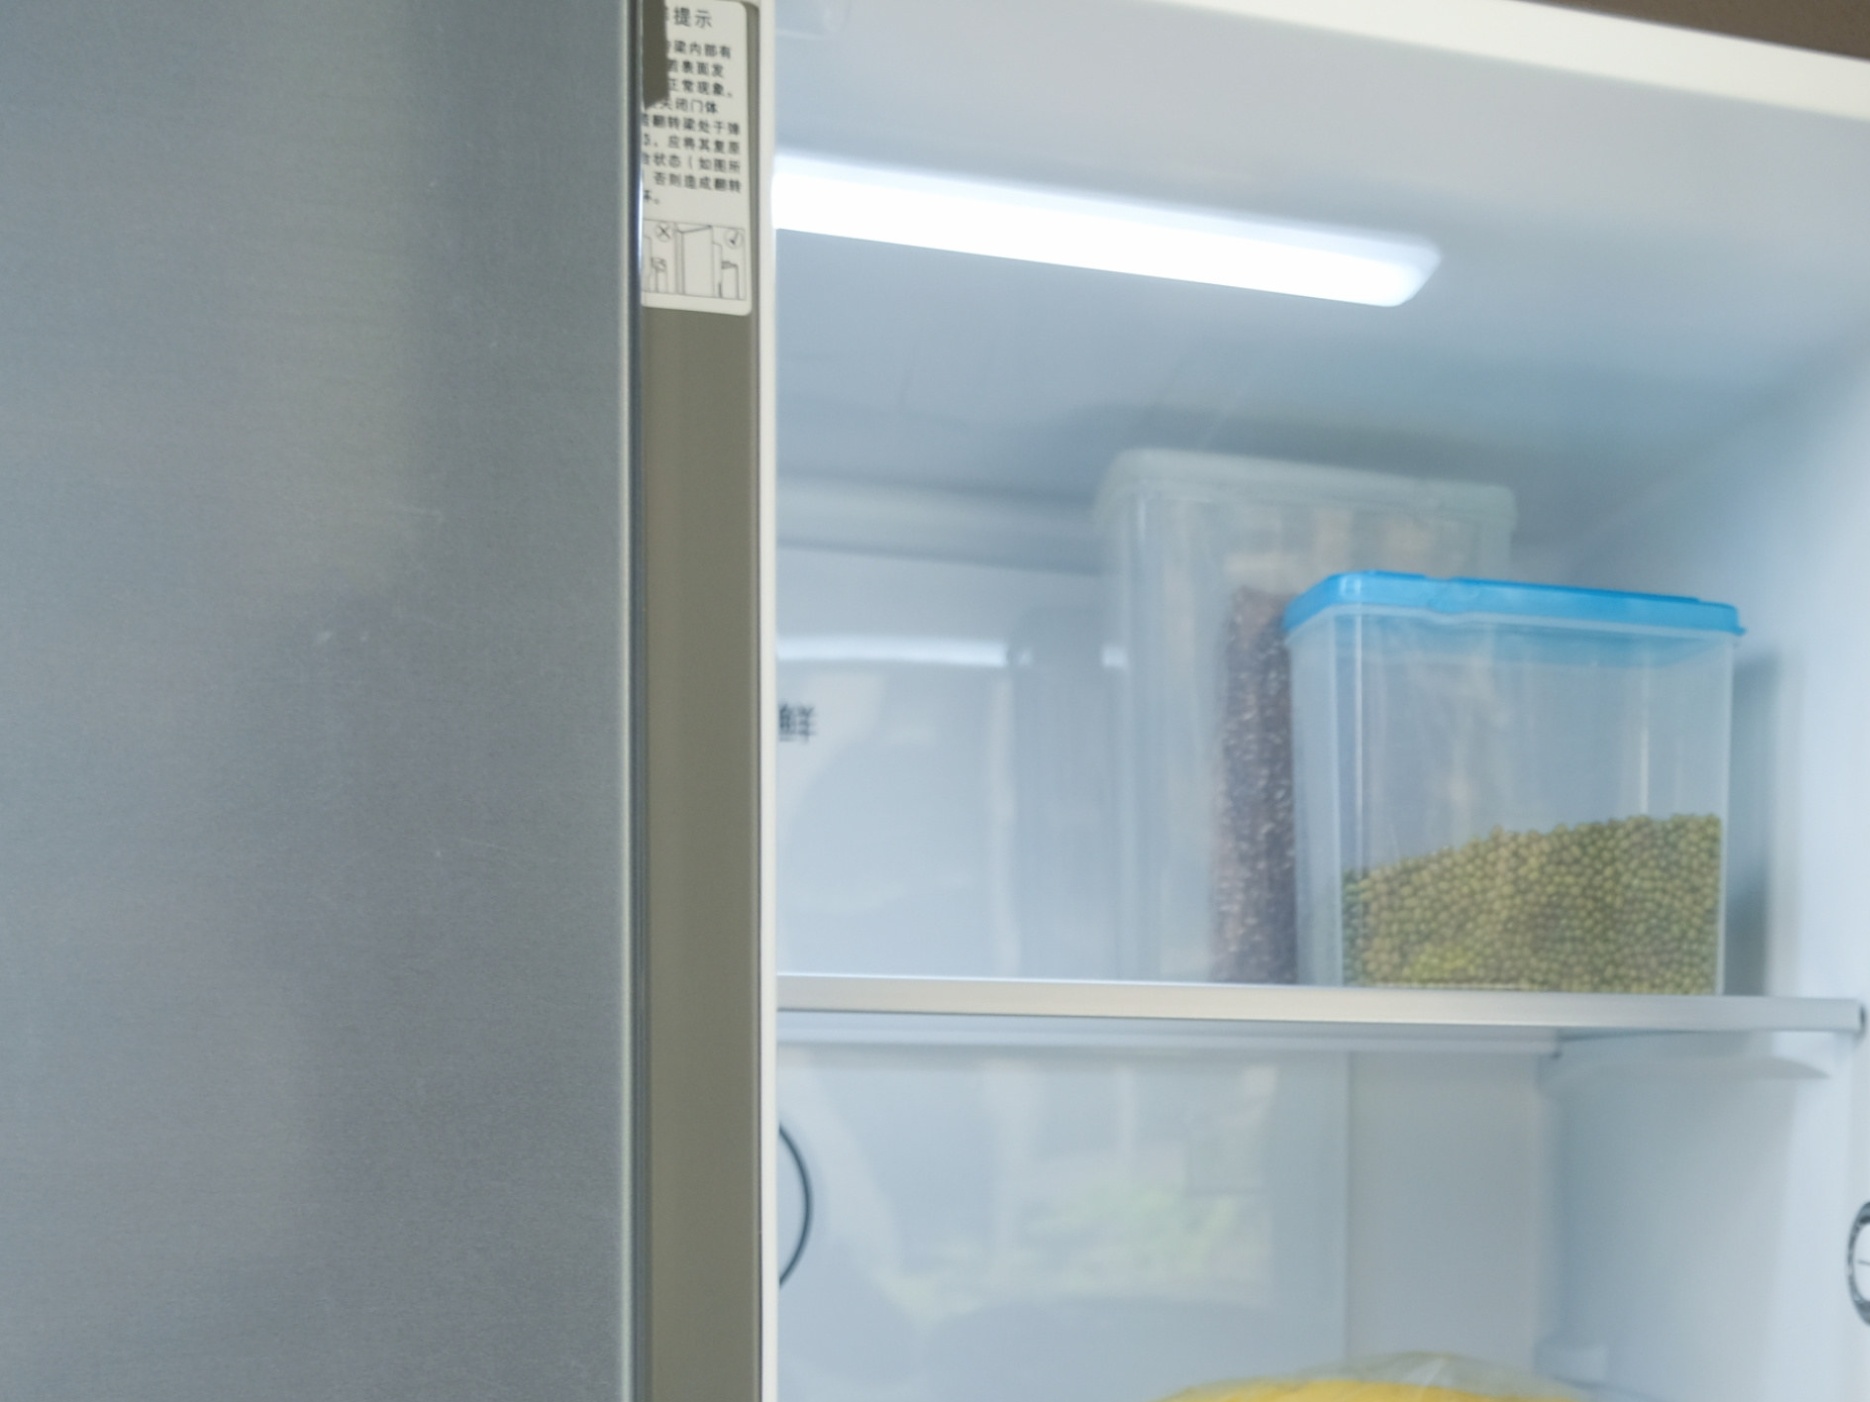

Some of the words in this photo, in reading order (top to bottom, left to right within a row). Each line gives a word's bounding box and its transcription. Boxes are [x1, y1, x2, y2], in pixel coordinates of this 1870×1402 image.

[665, 6, 713, 28] 提示
[667, 40, 731, 59] 梁内部有
